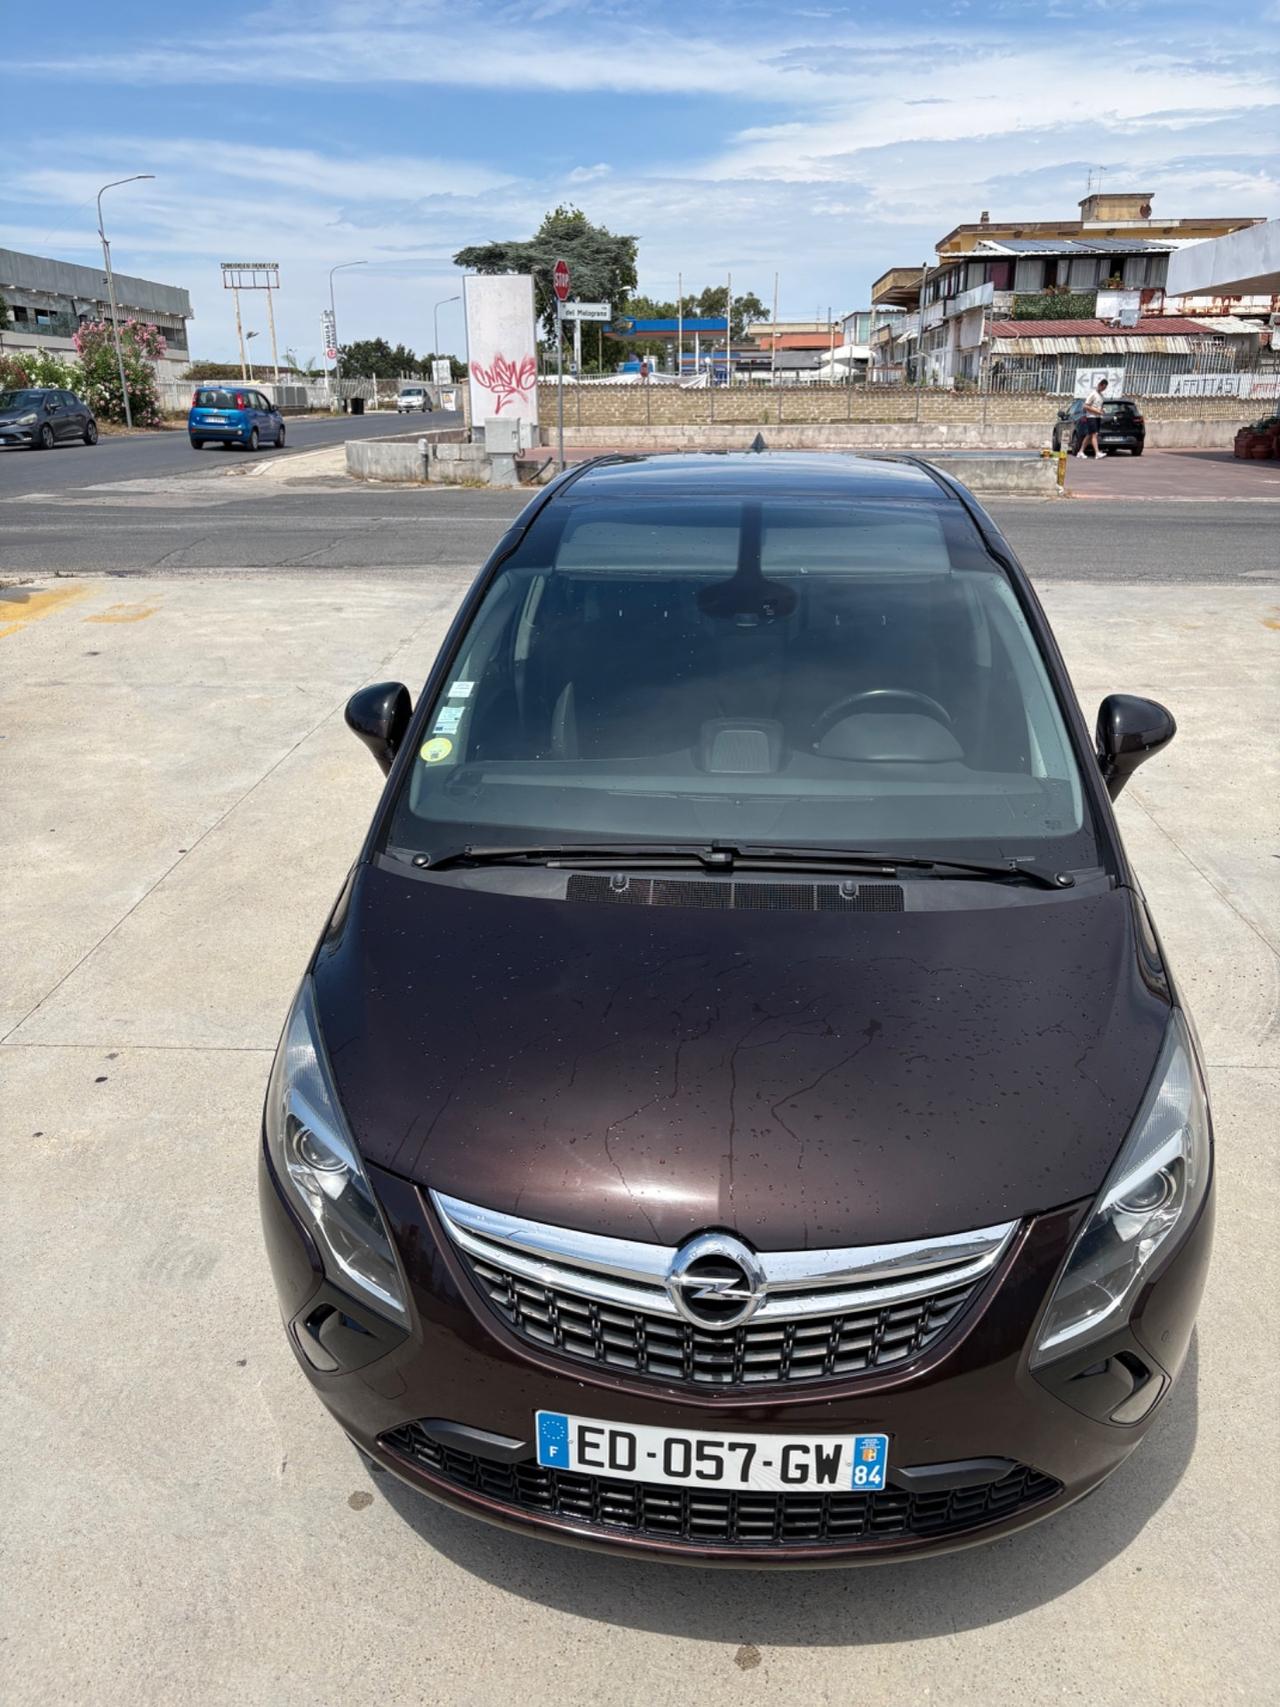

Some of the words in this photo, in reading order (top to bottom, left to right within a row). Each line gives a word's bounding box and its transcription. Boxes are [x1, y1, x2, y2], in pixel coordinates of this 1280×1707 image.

[555, 272, 569, 287] STOP
[549, 1445, 559, 1457] F
[577, 1425, 843, 1485] ED-057-GW
[854, 1465, 881, 1484] 84
